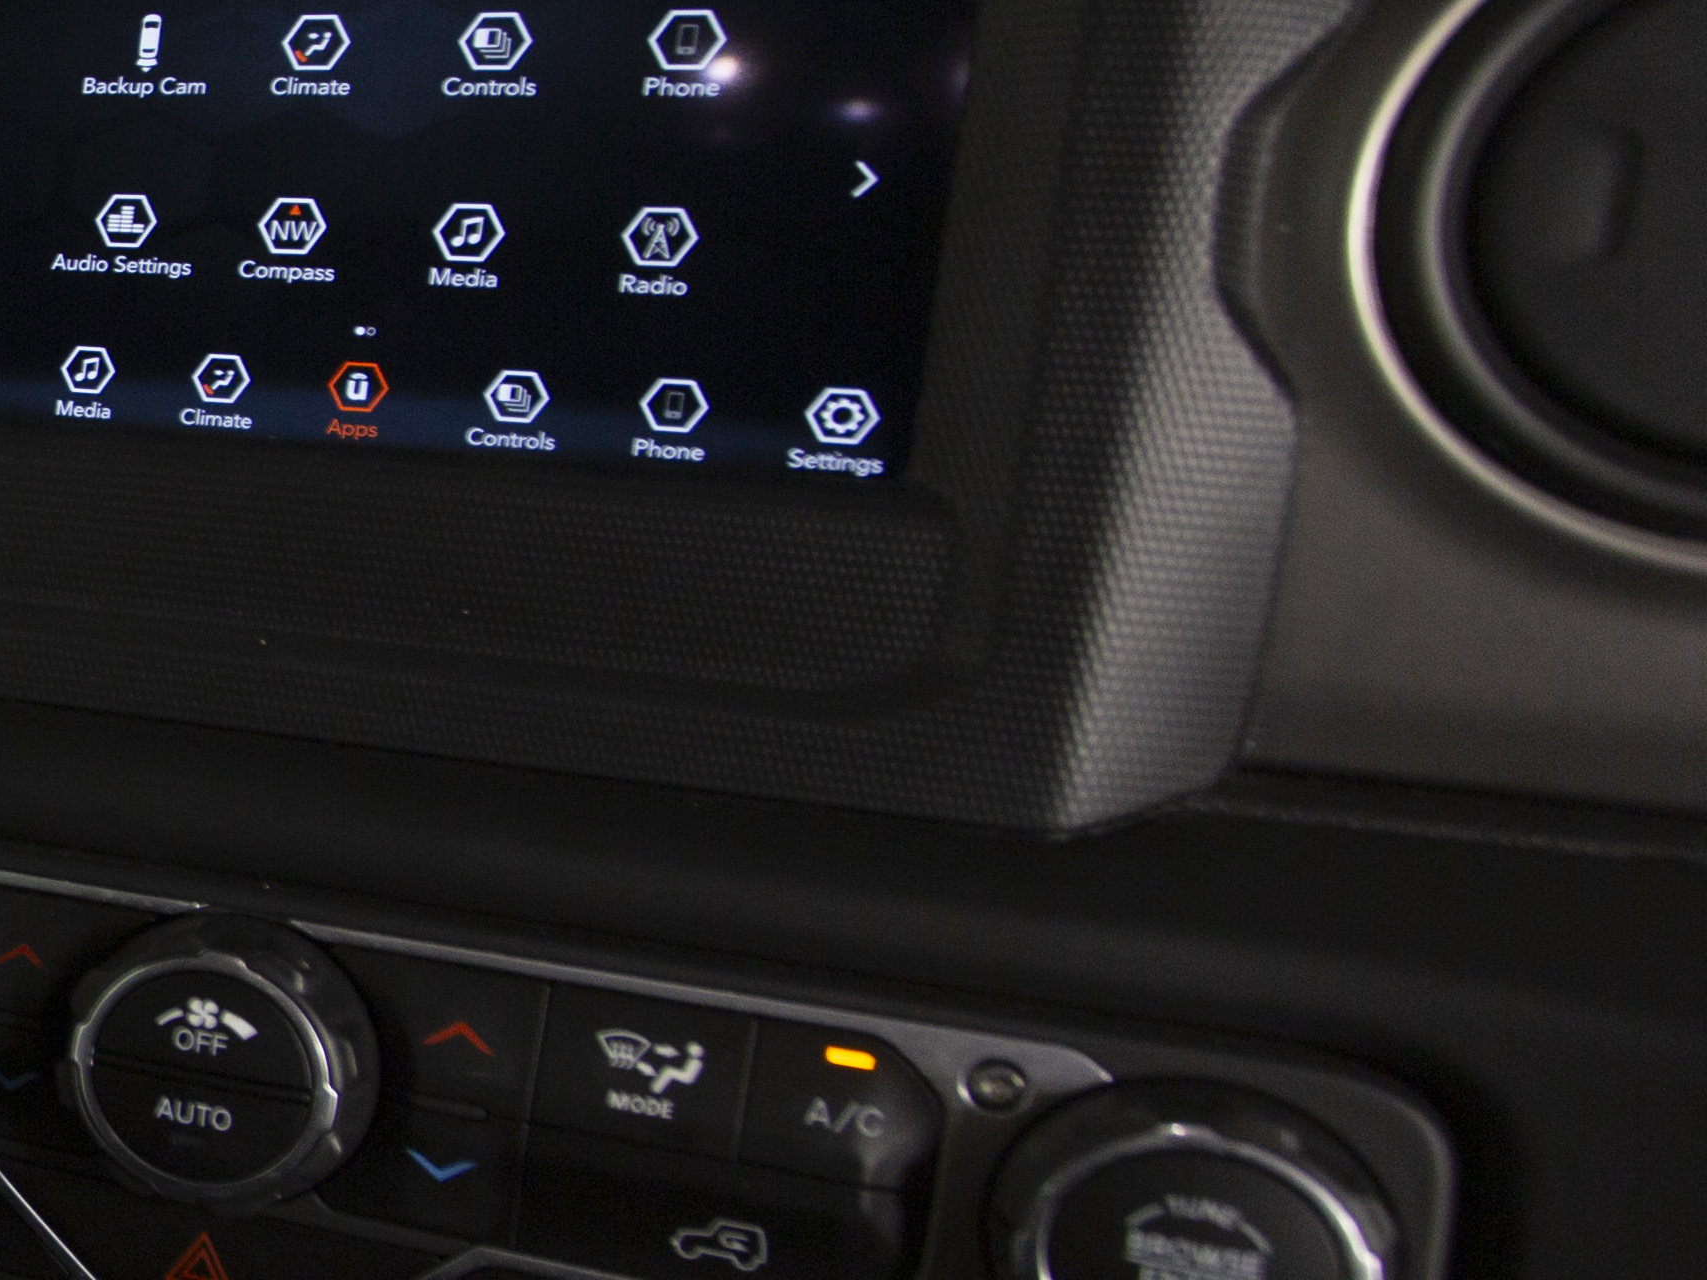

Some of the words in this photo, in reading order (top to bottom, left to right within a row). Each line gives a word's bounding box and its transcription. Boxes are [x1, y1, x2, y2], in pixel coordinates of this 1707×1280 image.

[82, 76, 153, 98] Backup
[160, 77, 207, 96] Cam
[270, 75, 351, 96] Climate
[442, 76, 537, 97] Controls
[643, 77, 720, 98] Phone
[269, 218, 316, 243] NW
[51, 253, 109, 273] Audio
[113, 255, 192, 279] Settings
[238, 260, 336, 283] Compass
[428, 265, 499, 288] Media
[619, 274, 689, 296] Radio
[55, 400, 113, 419] Media
[180, 407, 253, 429] Climate
[327, 418, 377, 440] Apps
[466, 428, 556, 451] Controls
[632, 438, 706, 461] Phone
[787, 448, 885, 477] Settings
[172, 1031, 228, 1057] OFF
[152, 1095, 233, 1133] AUTO
[606, 1089, 675, 1120] MODE
[803, 1097, 885, 1138] A/C
